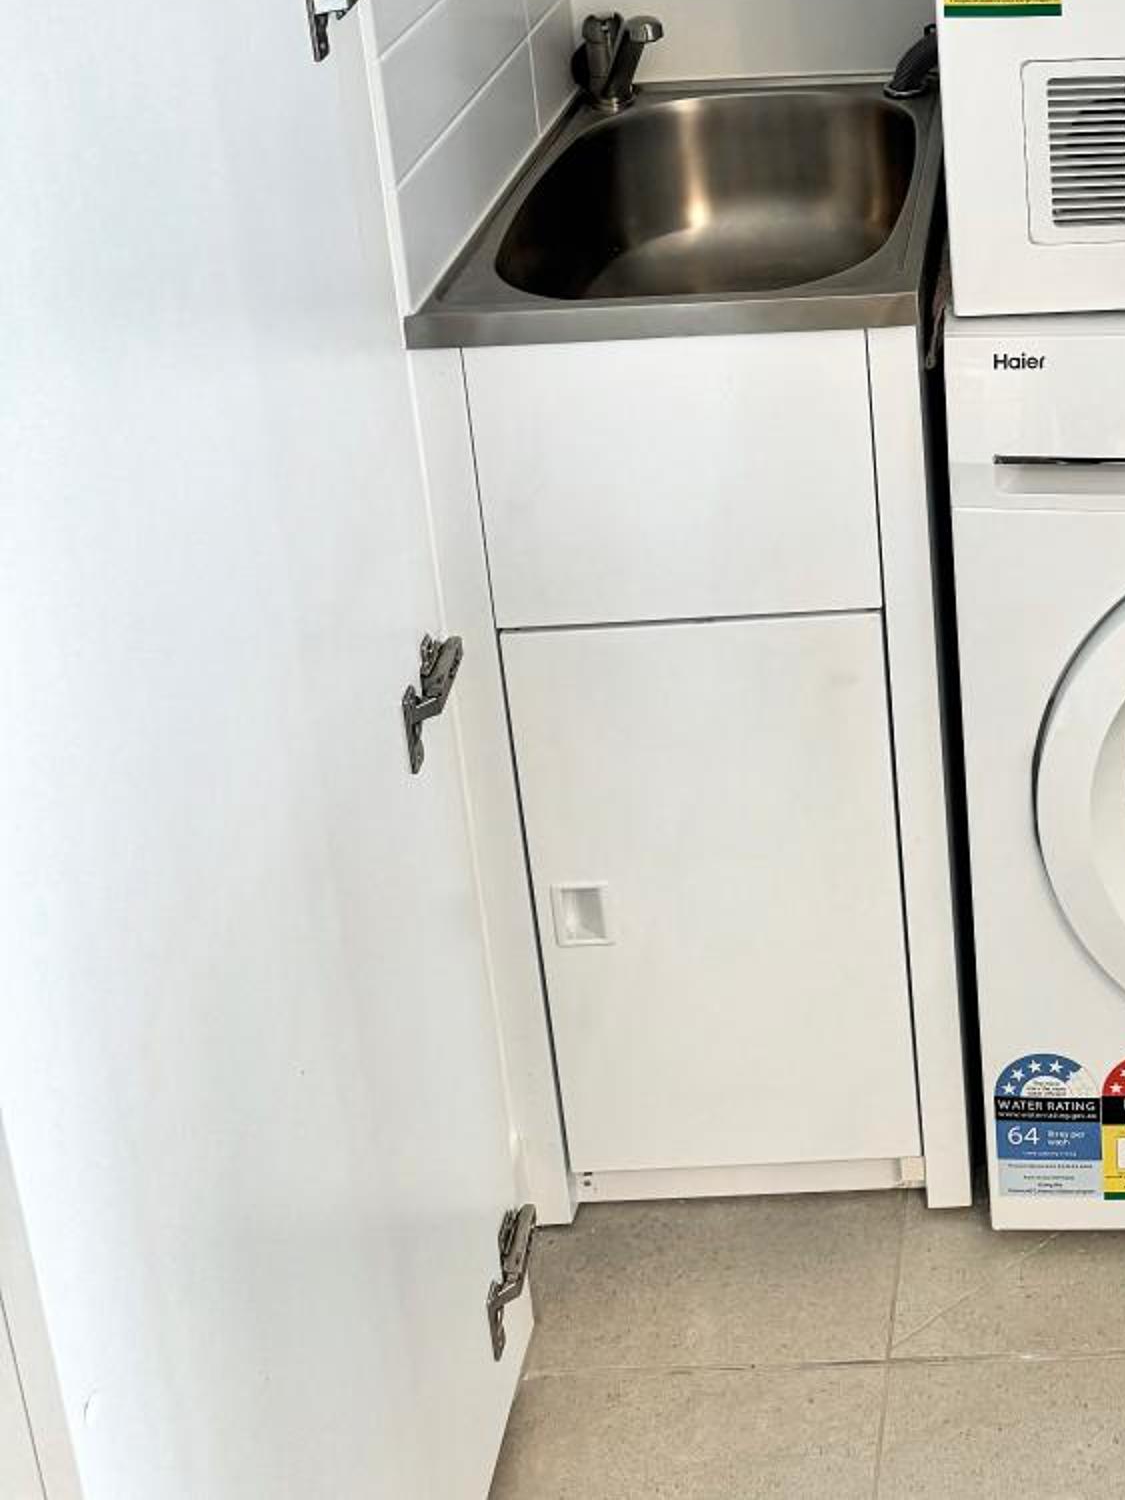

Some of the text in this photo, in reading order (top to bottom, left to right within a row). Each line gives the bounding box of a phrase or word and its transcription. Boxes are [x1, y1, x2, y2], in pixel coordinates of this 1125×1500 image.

[993, 352, 1046, 370] Haier
[997, 1100, 1096, 1111] WATER RATING
[1007, 1125, 1040, 1146] 64
